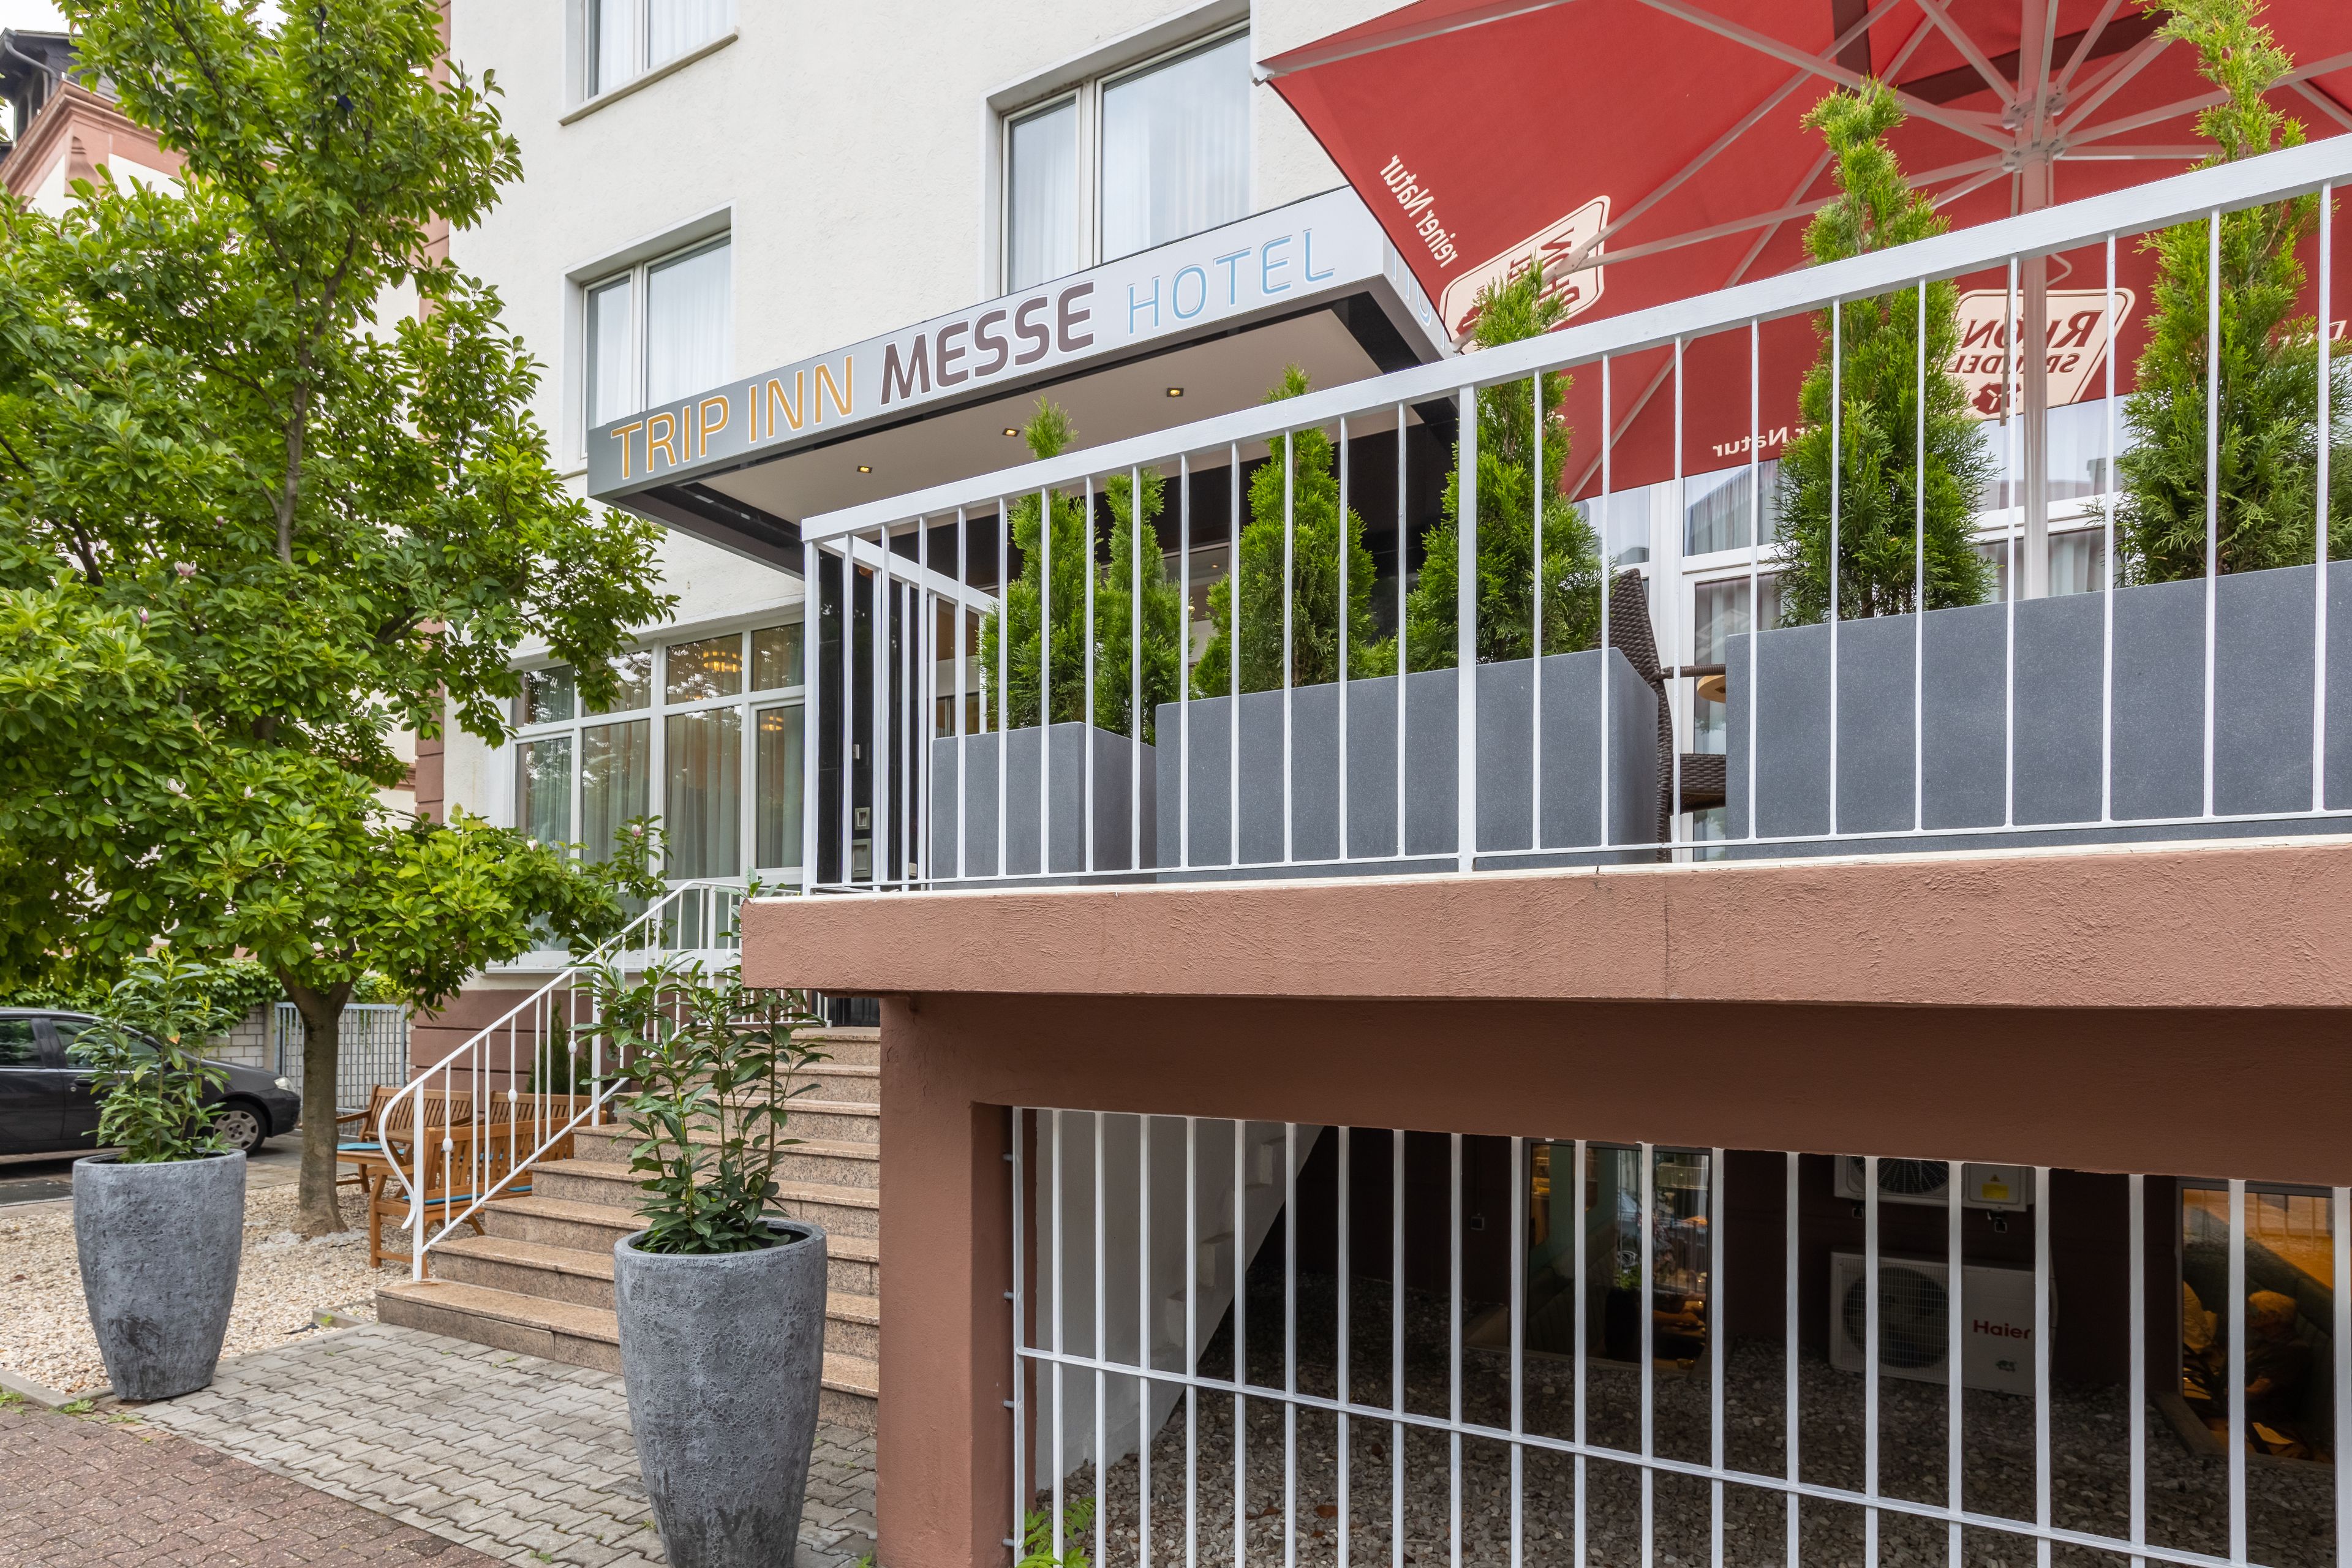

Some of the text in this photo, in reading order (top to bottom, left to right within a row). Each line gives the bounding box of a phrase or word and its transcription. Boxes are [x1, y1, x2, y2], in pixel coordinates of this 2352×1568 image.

[610, 394, 729, 480] TRIP
[748, 354, 854, 444] INN
[880, 280, 1096, 407] MESSE
[1127, 229, 1335, 336] HOTEL
[1973, 1319, 2032, 1340] Haier
